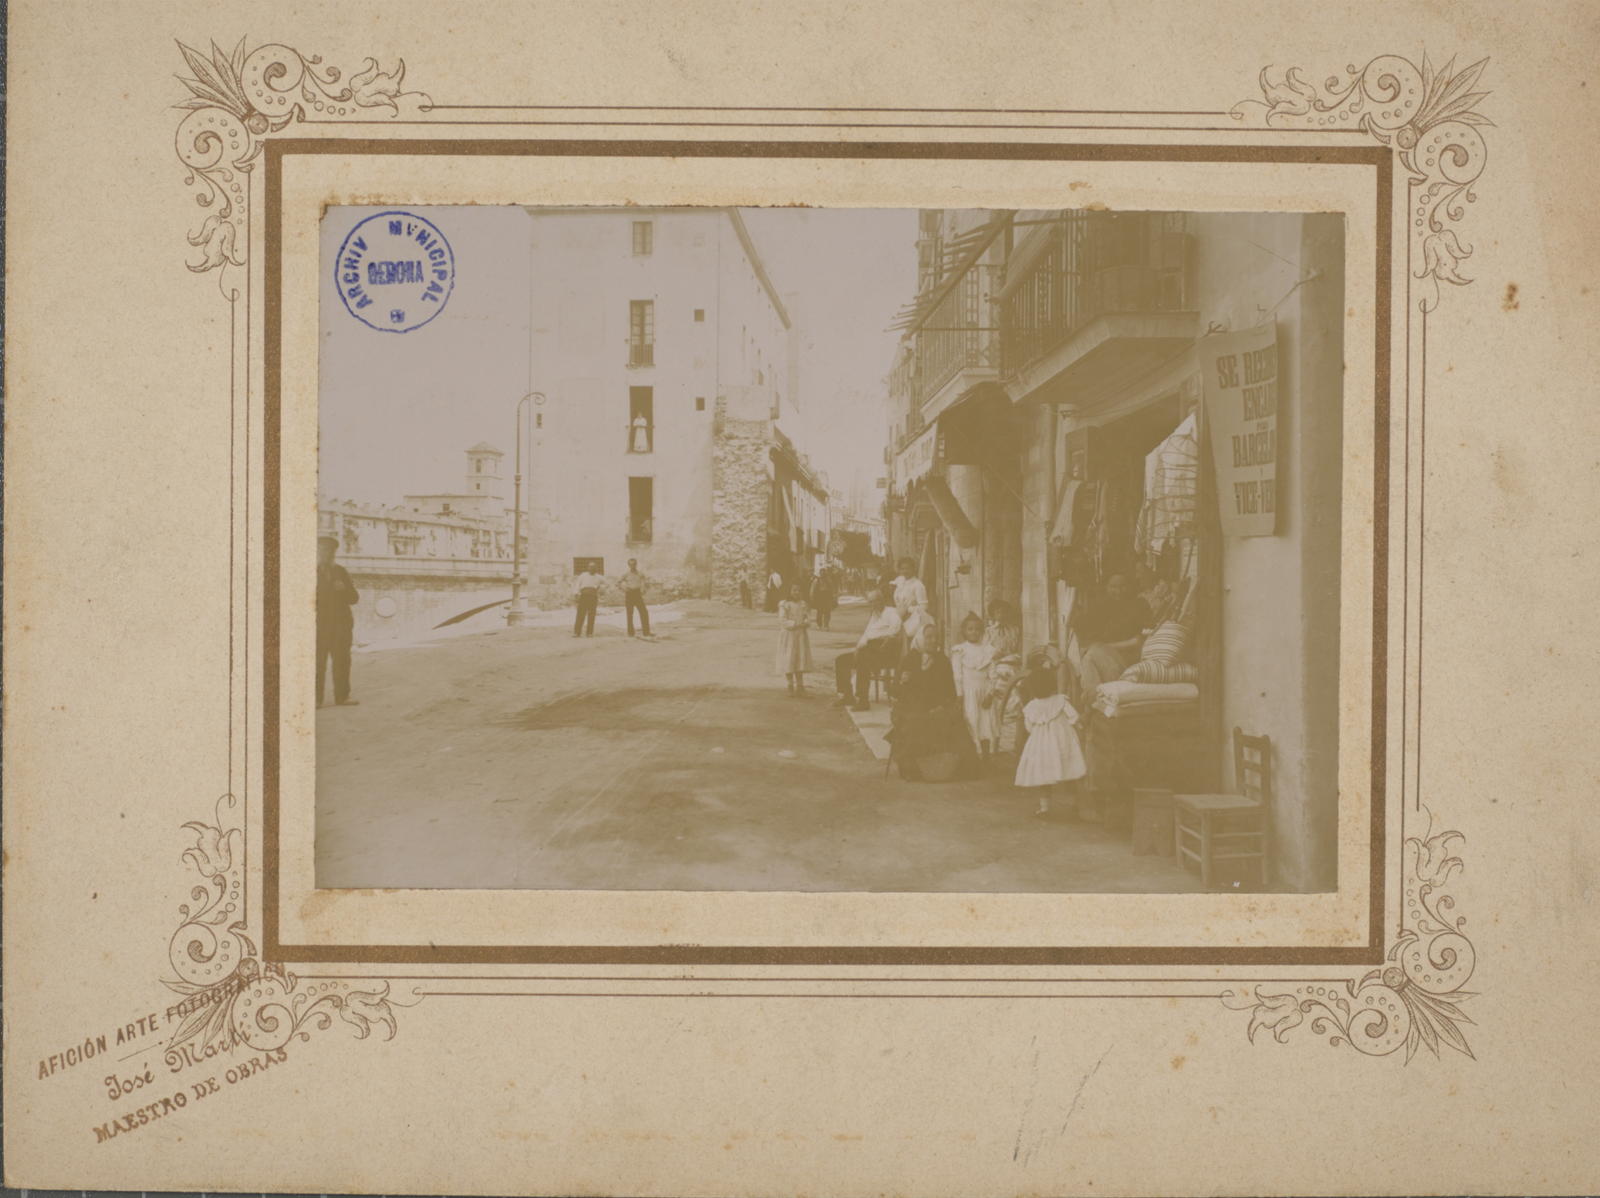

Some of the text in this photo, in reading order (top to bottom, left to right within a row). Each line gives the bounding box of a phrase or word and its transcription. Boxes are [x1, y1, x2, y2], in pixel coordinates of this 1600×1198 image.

[367, 260, 424, 285] GERONA
[1216, 353, 1240, 390] SE
[38, 1035, 107, 1080] AFICIÓN
[116, 1013, 160, 1046] ARTE
[92, 1047, 288, 1143] MAESTRO DE OBRAS
[104, 1062, 155, 1100] José
